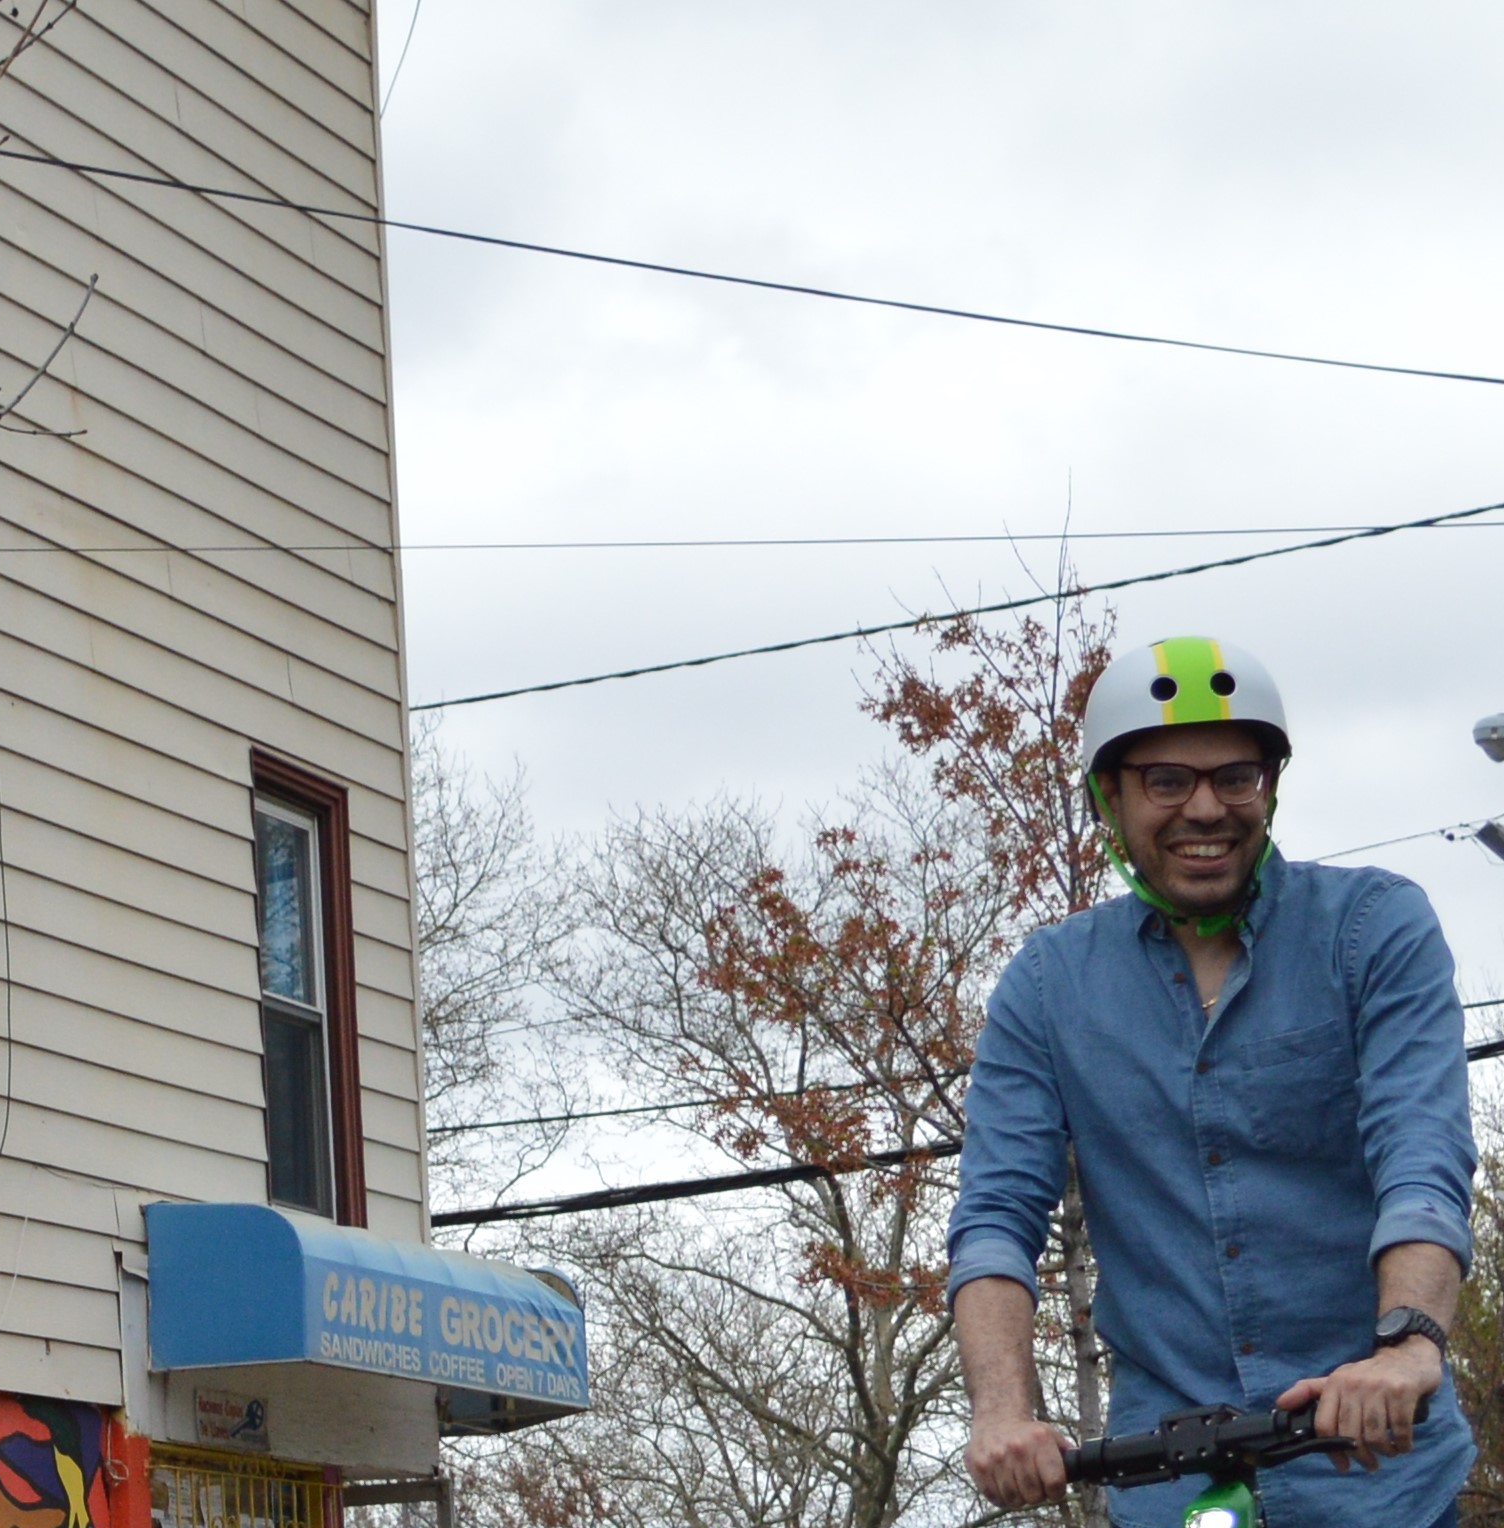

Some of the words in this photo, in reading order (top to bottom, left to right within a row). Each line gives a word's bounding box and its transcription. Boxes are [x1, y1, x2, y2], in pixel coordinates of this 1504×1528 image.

[323, 1271, 423, 1337] CARIBE
[440, 1296, 577, 1368] GROCERY
[320, 1332, 421, 1372] SANDWICHES
[429, 1352, 486, 1383] COFFEE
[496, 1363, 533, 1391] OPEN
[535, 1371, 543, 1391] 7
[548, 1374, 581, 1399] DAYS
